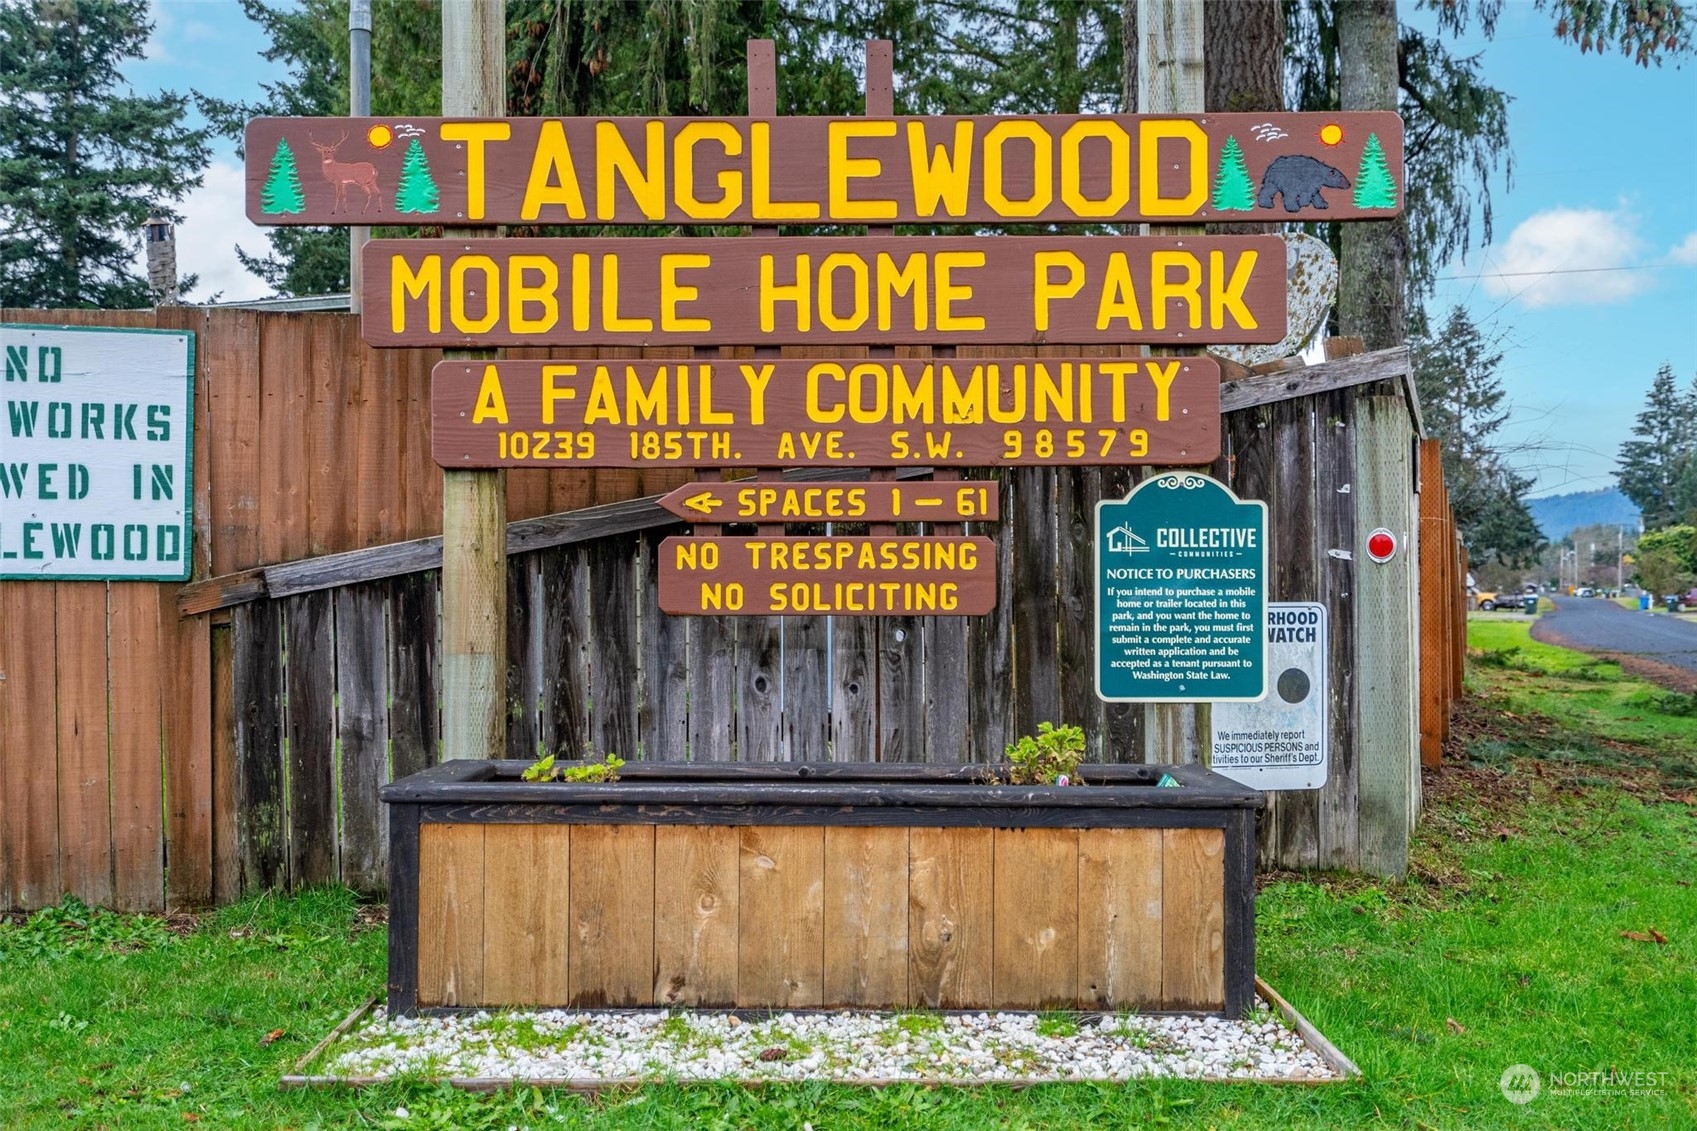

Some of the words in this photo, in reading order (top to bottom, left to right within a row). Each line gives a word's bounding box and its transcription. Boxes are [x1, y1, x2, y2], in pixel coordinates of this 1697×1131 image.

[440, 120, 1209, 220] TANGLEWOOD
[390, 253, 711, 334] MOBILE
[759, 252, 986, 333] HOME
[1033, 250, 1258, 332] PARK
[7, 346, 62, 382] NO
[472, 364, 509, 425] A
[541, 364, 775, 427] FAMILY
[805, 361, 1181, 425] COMMUNITY
[9, 401, 171, 440] WORKS
[498, 431, 595, 459] 10239
[629, 431, 741, 459] 185TH.
[777, 431, 855, 460] AVE.
[890, 431, 963, 460] S.W.
[134, 464, 173, 500] IN
[738, 488, 866, 517] SPACES
[956, 487, 988, 516] 61
[1157, 529, 1256, 547] COLLECTIVE
[676, 542, 719, 570] NO
[744, 542, 977, 570] TRESPASSING
[1107, 568, 1153, 579] NOTICE
[1155, 568, 1173, 579] TO
[1176, 568, 1255, 579] PURCHASERS
[700, 582, 743, 610] NO
[769, 583, 958, 611] SOLICITING
[1107, 586, 1114, 595] If
[1116, 589, 1132, 597] you
[1134, 586, 1162, 595] intend
[1164, 587, 1174, 595] to
[1176, 586, 1215, 598] purchase
[1225, 586, 1255, 595] mobile
[1116, 598, 1141, 607] home
[1155, 598, 1182, 607] trailer
[1184, 598, 1216, 607] located
[1219, 598, 1227, 607] in
[1230, 598, 1245, 607] this
[1112, 610, 1134, 621] park,
[1136, 610, 1153, 619] and
[1155, 613, 1171, 621] you
[1174, 611, 1195, 619] want
[1197, 610, 1212, 619] the
[1214, 610, 1239, 619] home
[1241, 611, 1250, 619] to
[1109, 622, 1139, 631] remain
[1142, 622, 1150, 631] in
[1153, 622, 1167, 631] the
[1169, 622, 1191, 633] park,
[1194, 625, 1210, 633] you
[1212, 623, 1233, 631] must
[1236, 622, 1253, 631] first
[1112, 634, 1141, 643] submit
[1151, 634, 1192, 645] complete
[1194, 634, 1210, 643] and
[1212, 635, 1250, 643] accurate
[1123, 646, 1155, 655] written
[1157, 646, 1206, 657] application
[1208, 646, 1225, 655] and
[1227, 646, 1238, 655] be
[1110, 658, 1150, 669] accepted
[1171, 659, 1199, 667] tenant
[1202, 659, 1240, 669] pursuant
[1242, 659, 1252, 667] to
[1132, 670, 1183, 681] Washington
[1186, 670, 1208, 679] State
[1210, 671, 1230, 679] Law.
[1217, 731, 1229, 740] We
[1231, 730, 1279, 741] immediately
[1280, 730, 1304, 741] report
[1214, 742, 1263, 752] SUSPICIOUS
[1264, 741, 1303, 752] PERSONS
[1304, 743, 1318, 751] and
[1240, 754, 1248, 763] to
[1250, 755, 1262, 763] our
[1264, 753, 1297, 762] Sheriff's
[1298, 753, 1320, 764] Dept.
